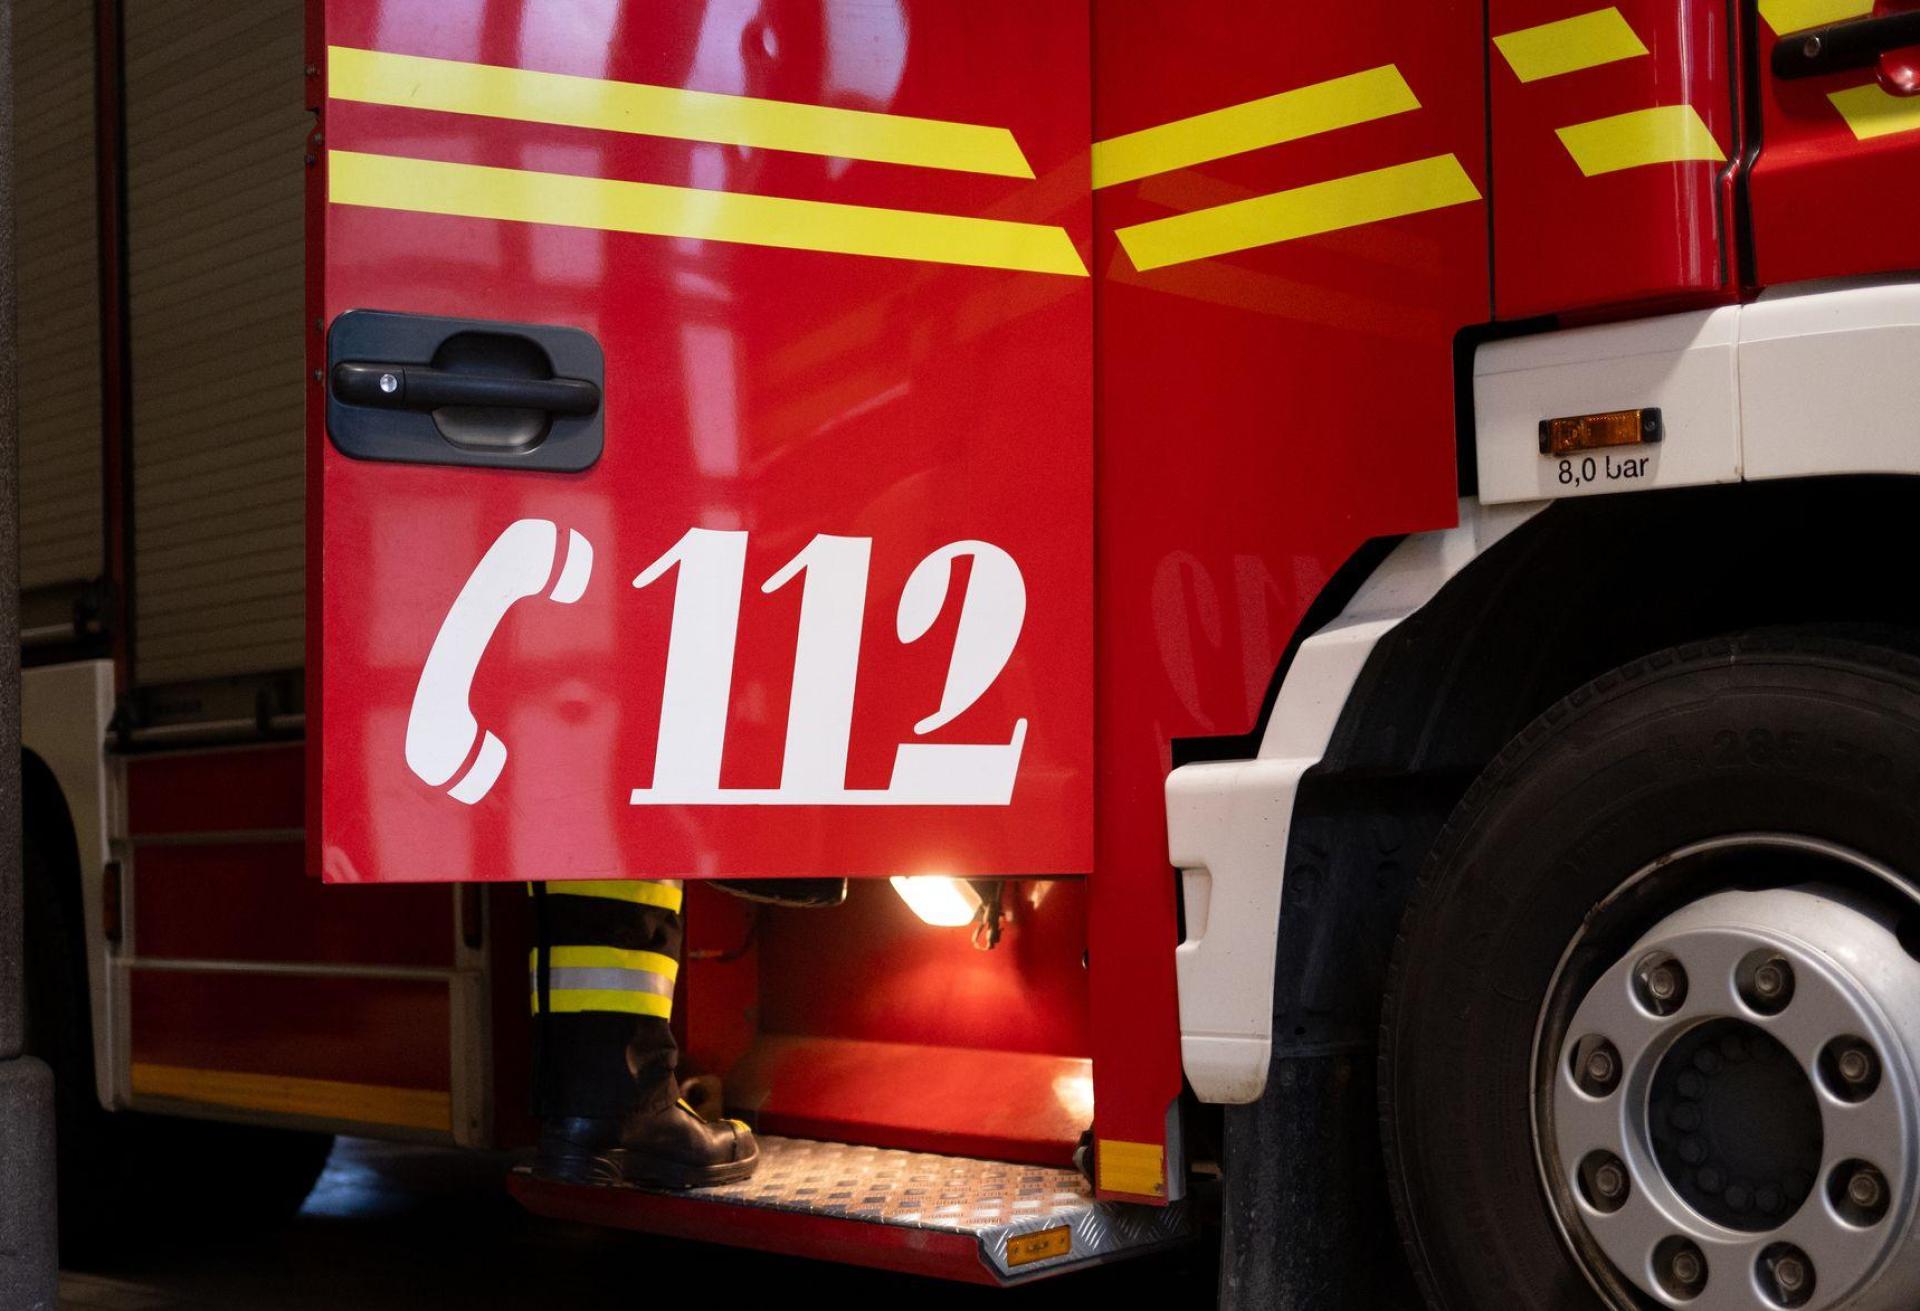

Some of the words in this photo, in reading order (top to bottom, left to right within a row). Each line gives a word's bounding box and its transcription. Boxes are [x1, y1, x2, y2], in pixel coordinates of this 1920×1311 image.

[1559, 457, 1596, 487] 8,0
[1606, 456, 1649, 479] bar
[630, 527, 1028, 806] 112
